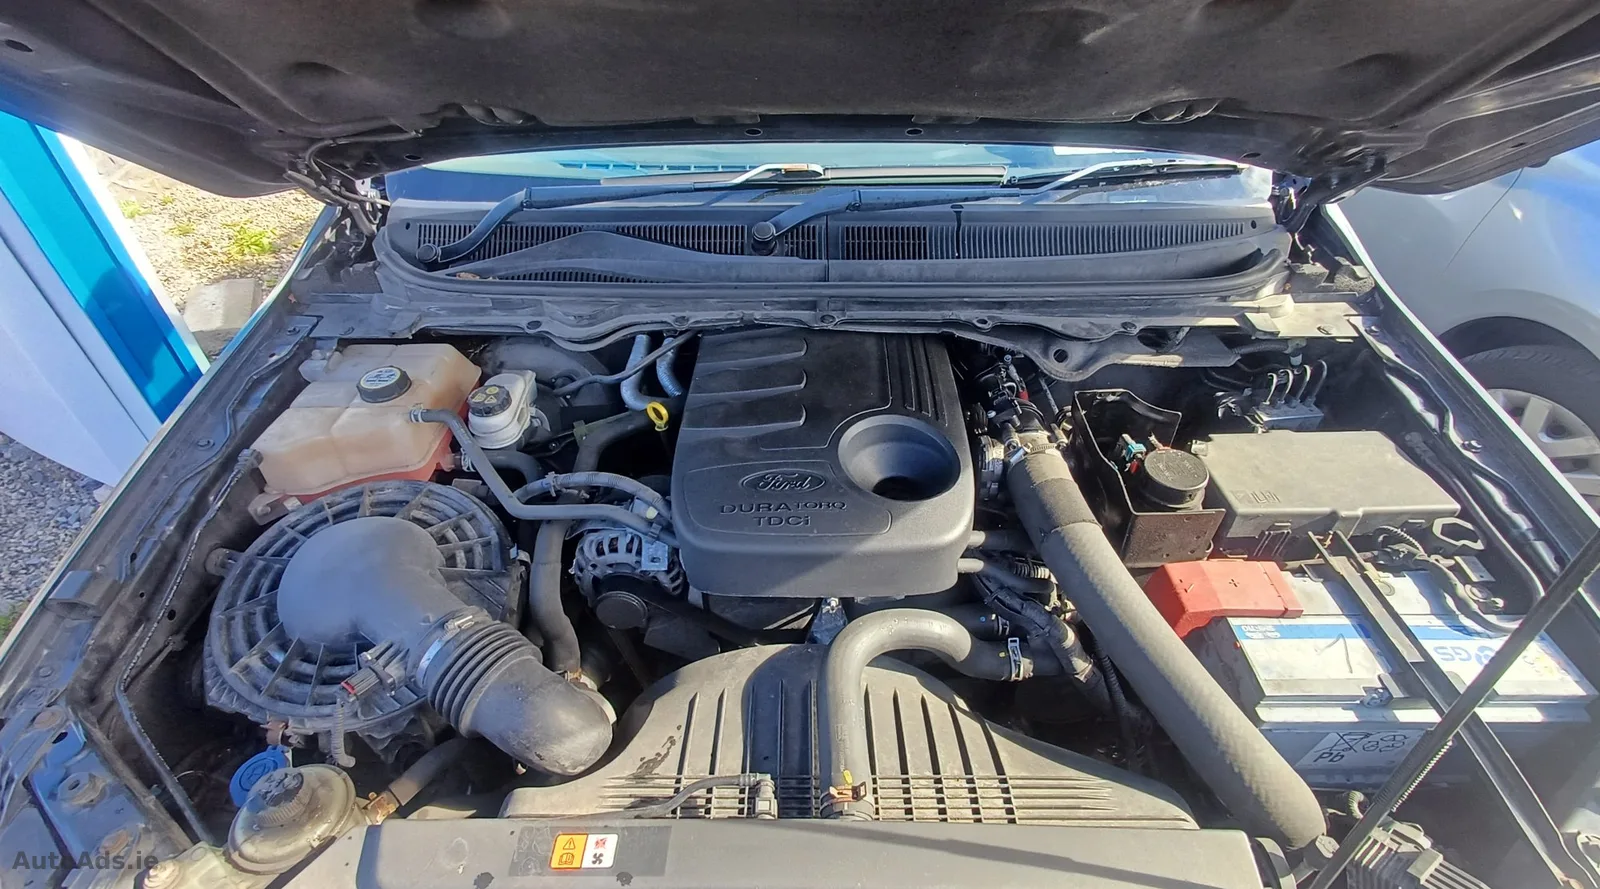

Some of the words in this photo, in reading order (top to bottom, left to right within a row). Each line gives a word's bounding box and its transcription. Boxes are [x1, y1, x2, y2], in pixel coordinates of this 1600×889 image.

[758, 472, 811, 491] Ford
[753, 514, 811, 527] TDCi
[1313, 751, 1345, 763] Pb
